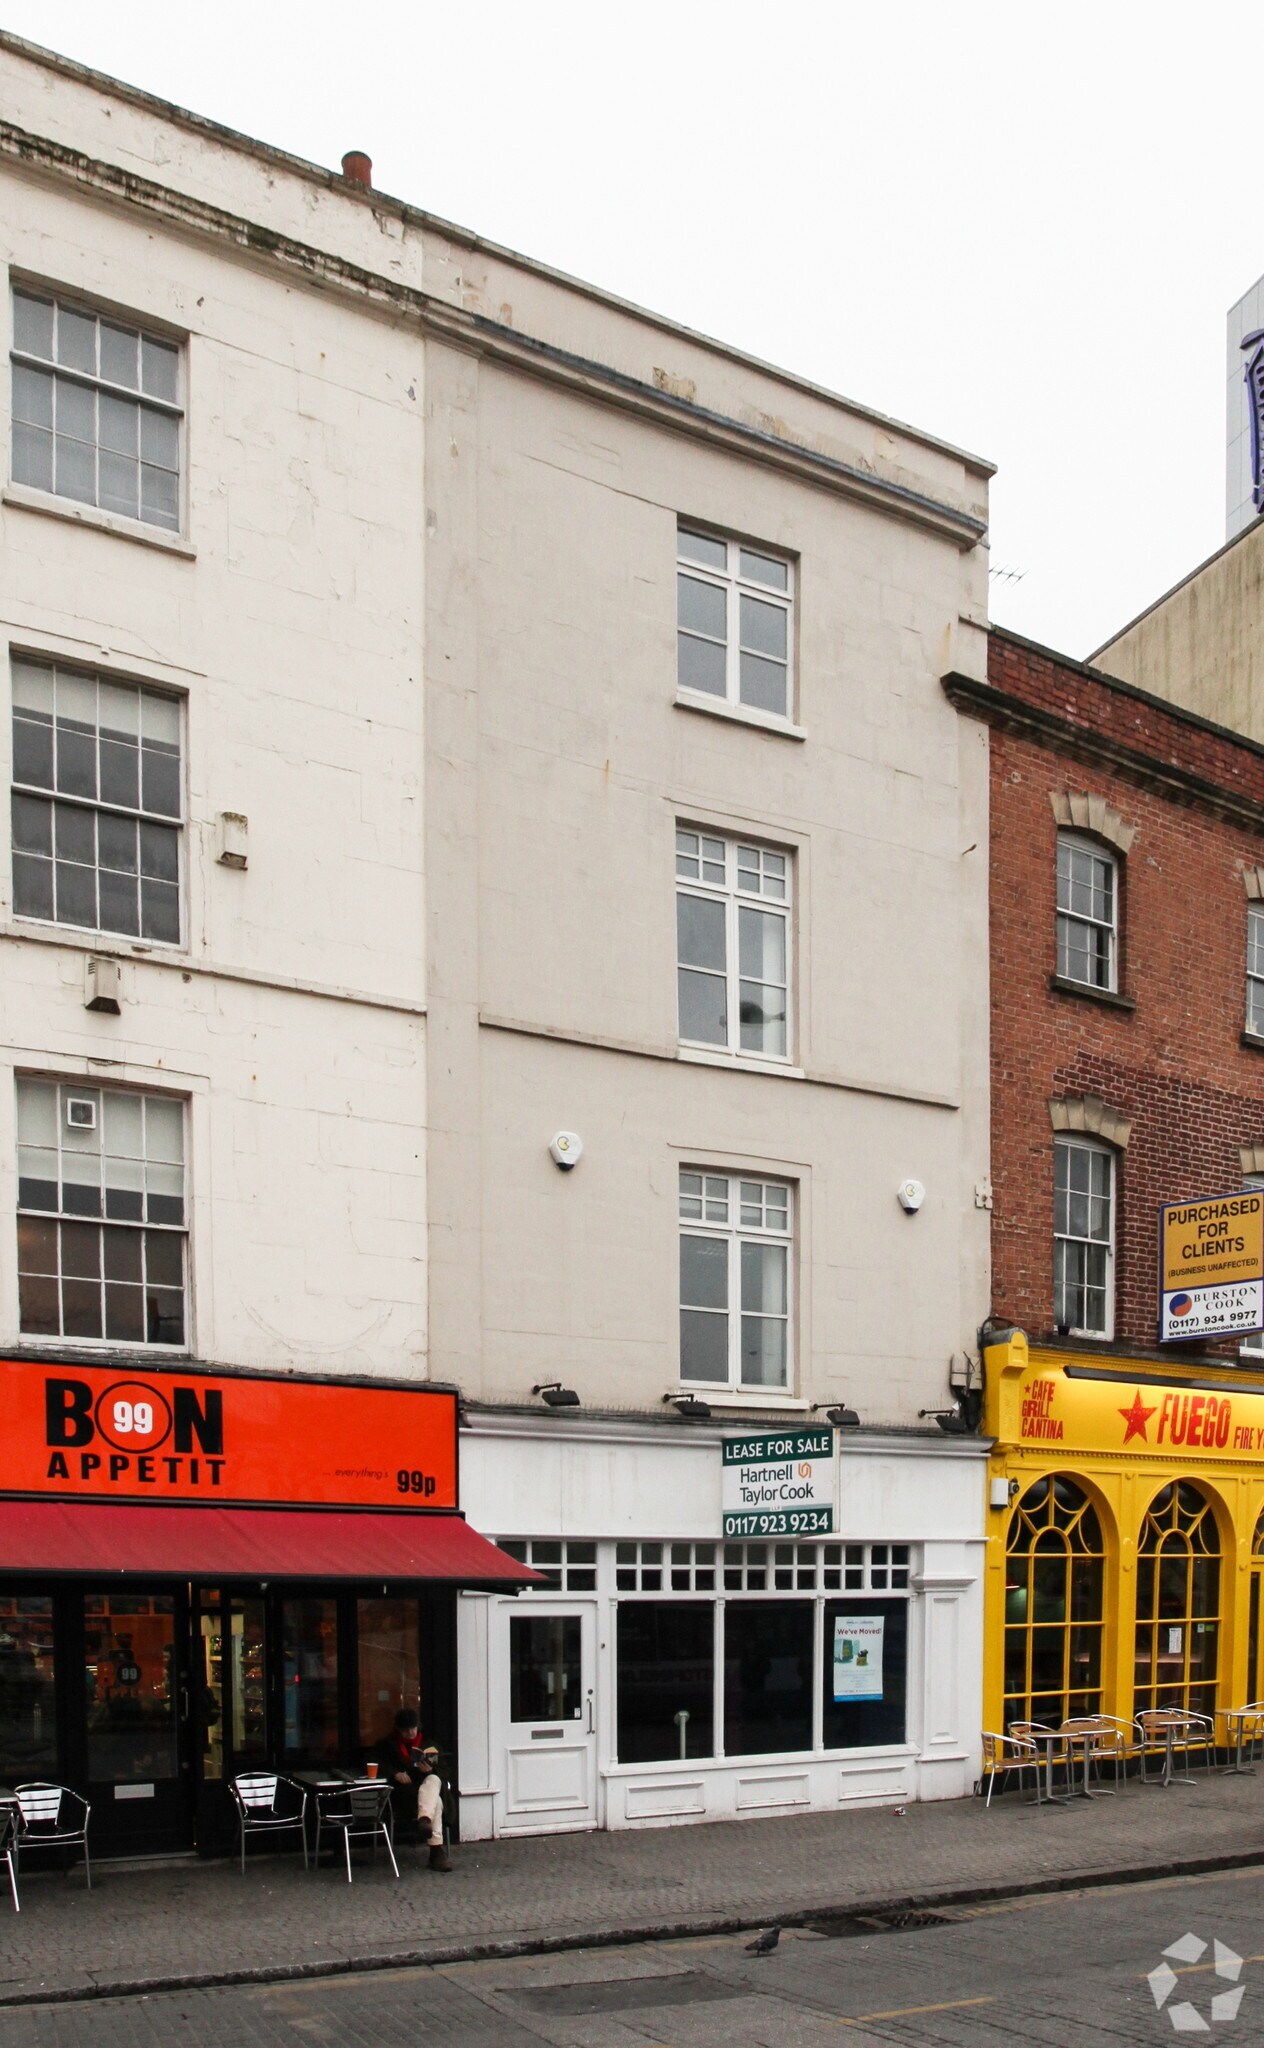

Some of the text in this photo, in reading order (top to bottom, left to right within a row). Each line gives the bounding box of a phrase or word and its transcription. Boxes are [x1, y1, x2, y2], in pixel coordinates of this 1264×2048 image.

[1168, 1198, 1260, 1226] PURCHASED
[1198, 1221, 1229, 1239] FOR
[1182, 1236, 1245, 1259] CLIENTS
[1168, 1258, 1259, 1279] (BUSINESS UNAFFECTED)
[1193, 1286, 1258, 1303] BURSTON
[1205, 1298, 1244, 1311] COOK
[1168, 1310, 1257, 1330] (0117) 934 9977
[1168, 1321, 1257, 1337] www.burstoncook.co.uk
[113, 1401, 153, 1434] 99
[1021, 1400, 1051, 1419] GRILL
[1156, 1393, 1232, 1449] FUEGO
[1021, 1417, 1064, 1440] CANTINA
[1233, 1426, 1264, 1450] FIRE Y
[726, 1436, 830, 1459] LEASE FOR SALE
[47, 1452, 226, 1486] APPETIT
[740, 1464, 793, 1483] Hartnell
[397, 1469, 436, 1497] 99p
[725, 1512, 829, 1535] 0117 923 9234
